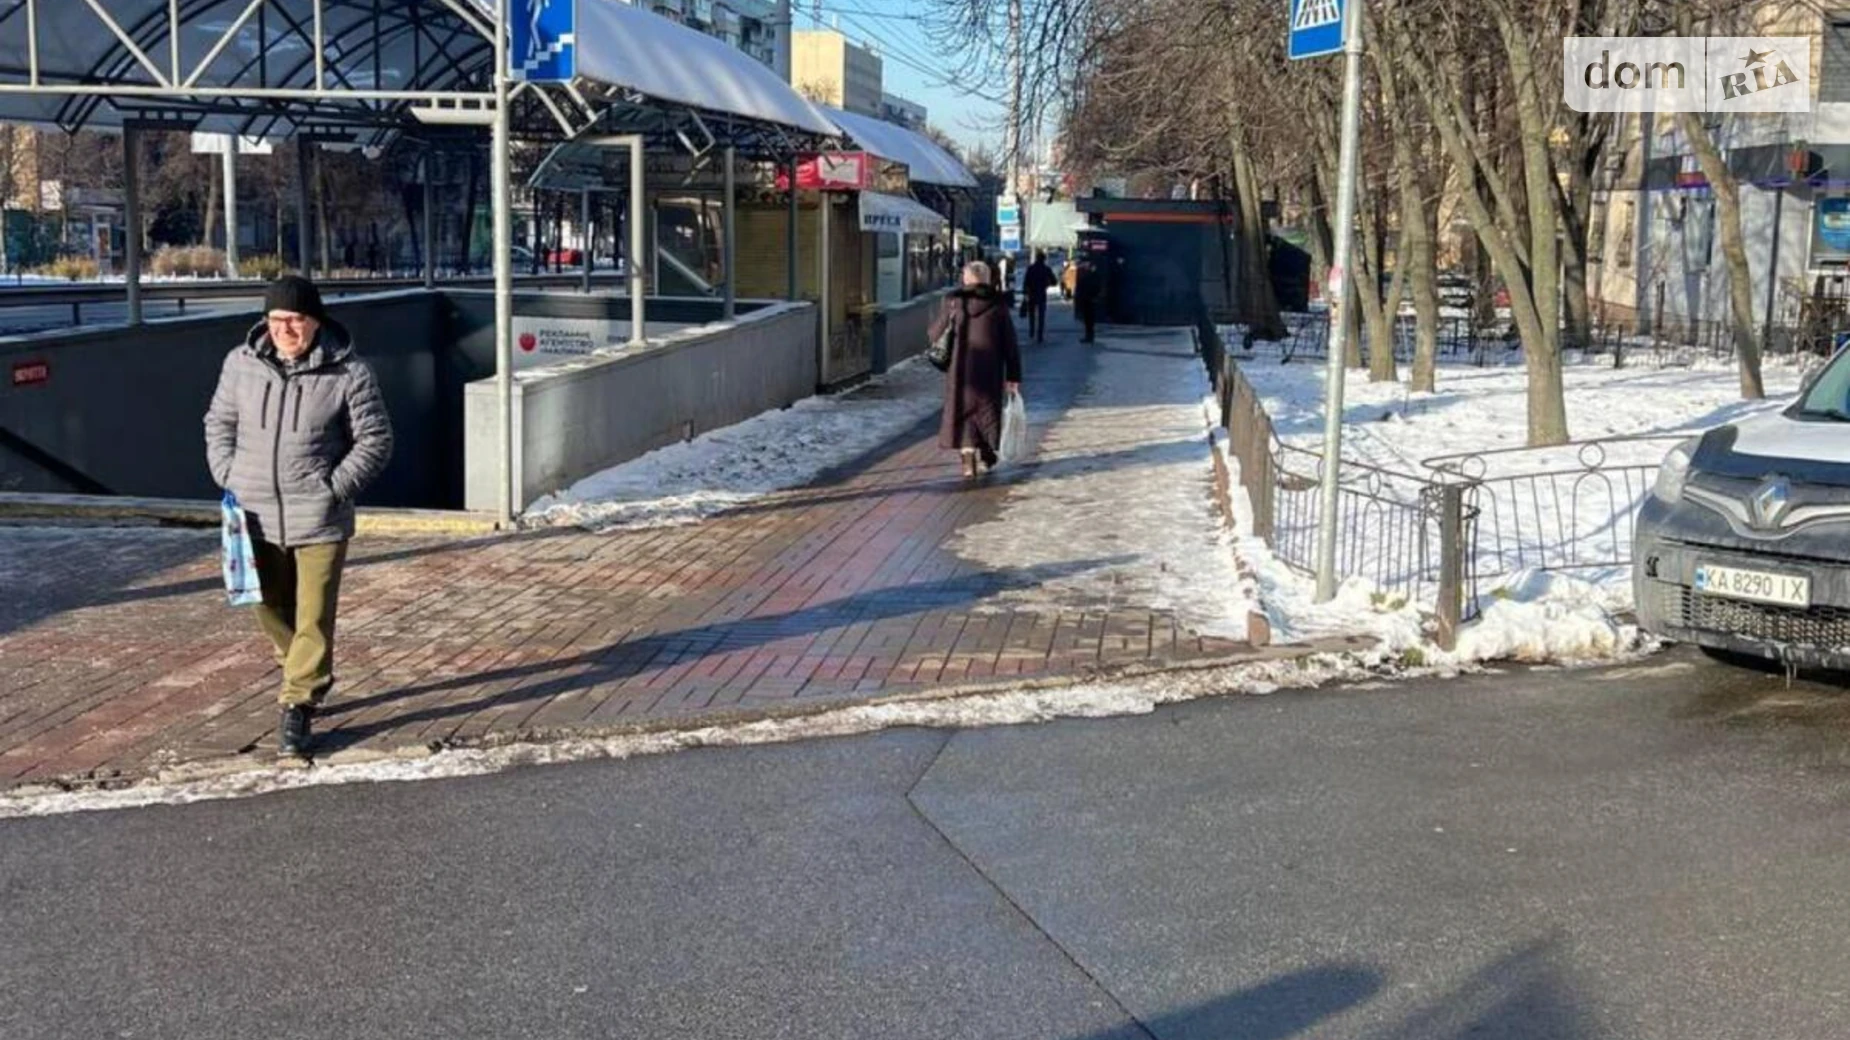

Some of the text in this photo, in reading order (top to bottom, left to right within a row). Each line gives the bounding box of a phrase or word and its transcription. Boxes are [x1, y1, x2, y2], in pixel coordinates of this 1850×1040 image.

[864, 214, 901, 226] ПРЕСА
[1706, 568, 1804, 601] KA 8290 IX
